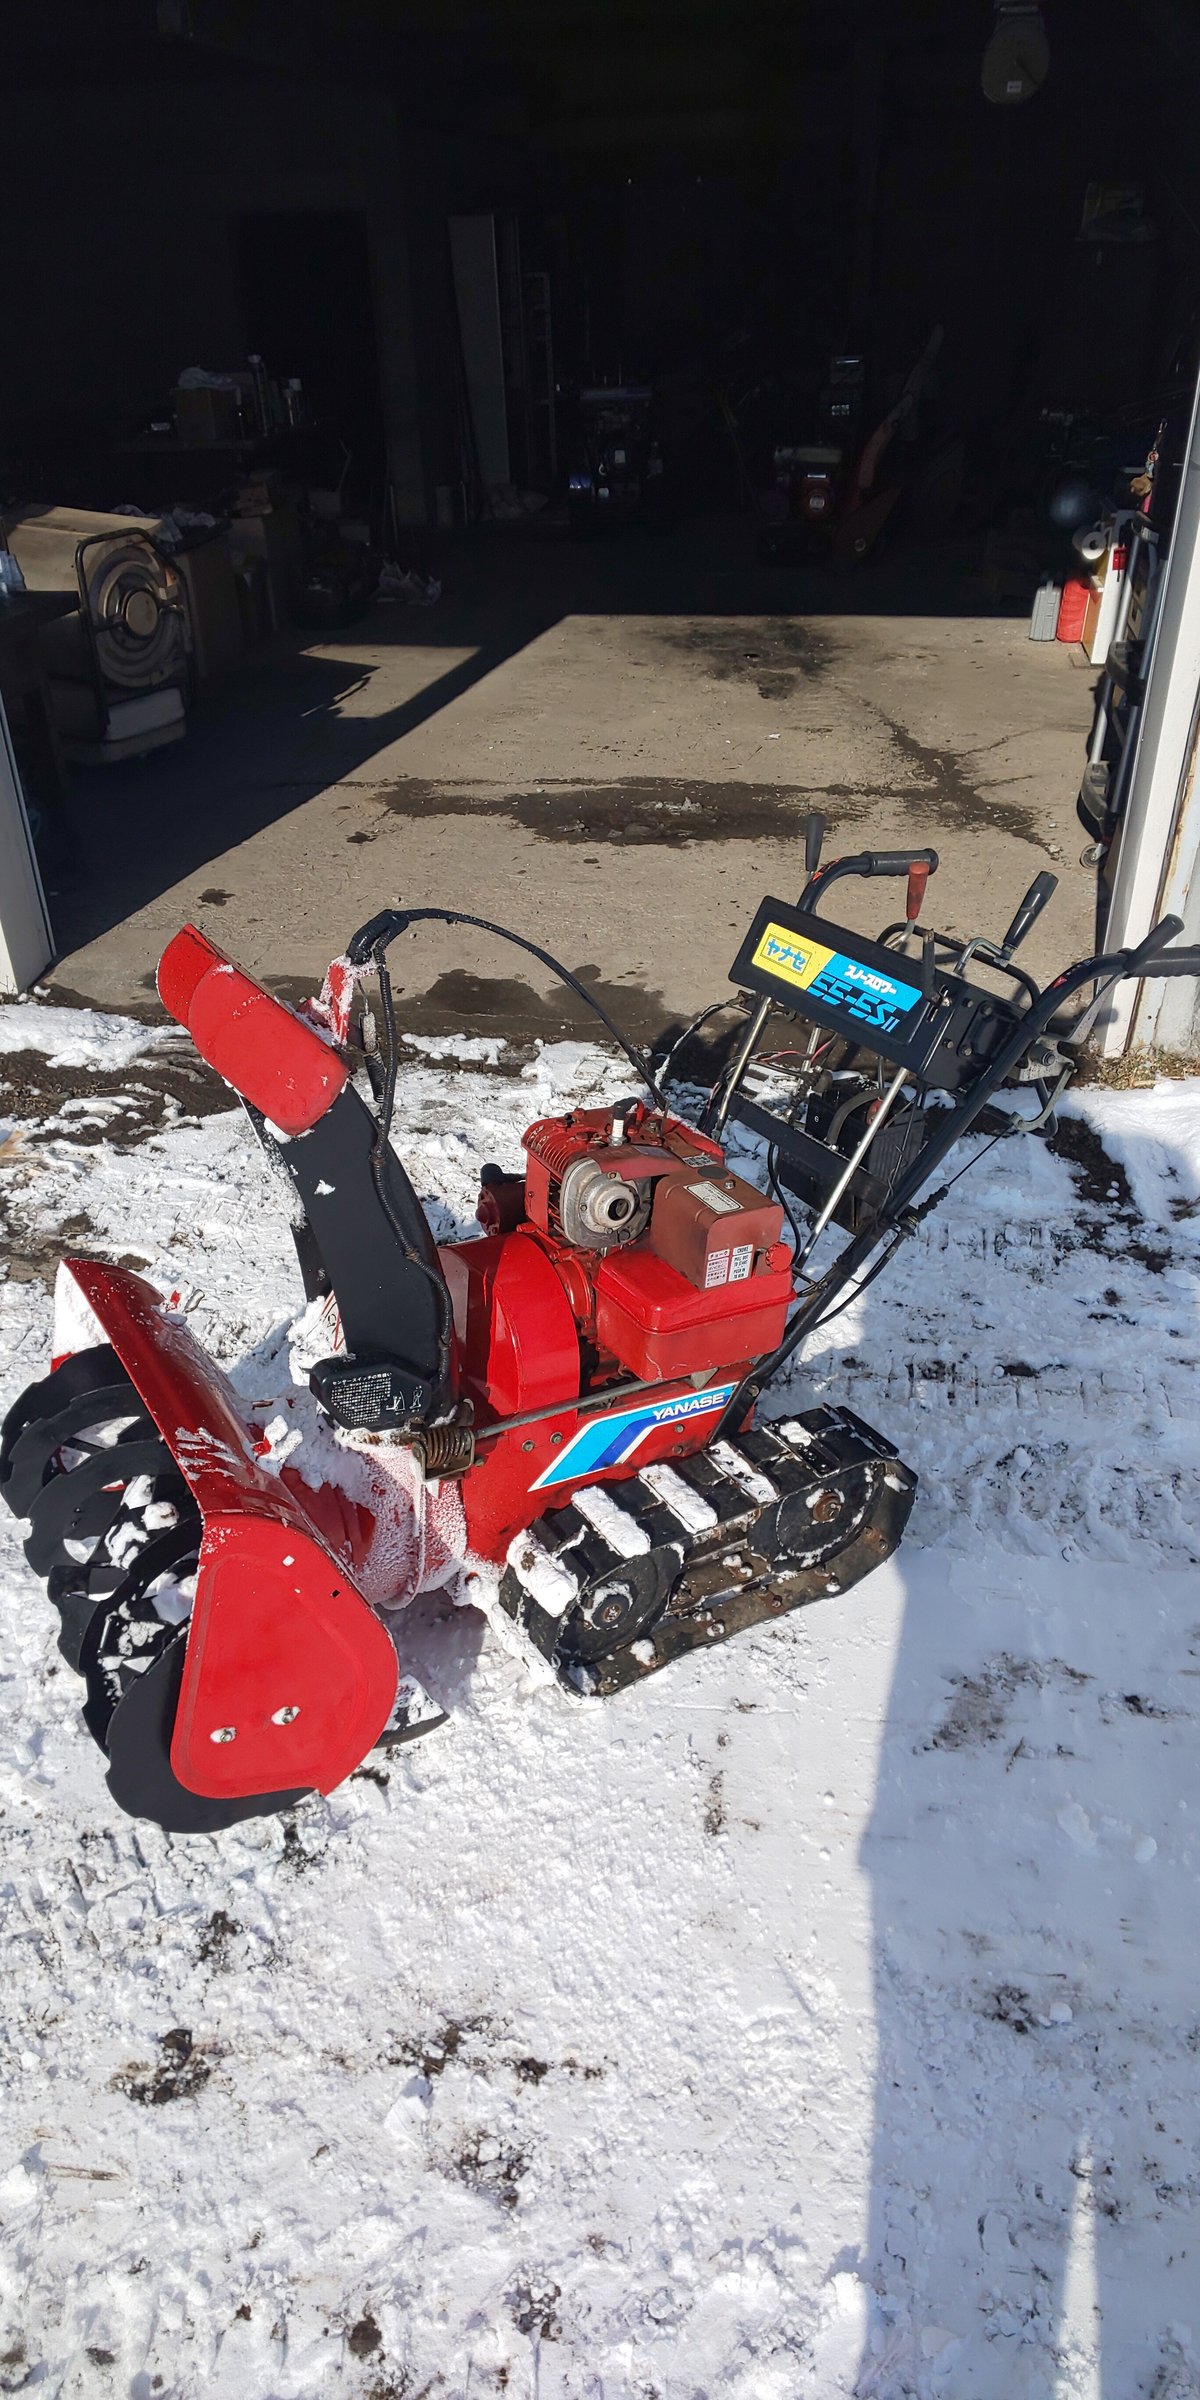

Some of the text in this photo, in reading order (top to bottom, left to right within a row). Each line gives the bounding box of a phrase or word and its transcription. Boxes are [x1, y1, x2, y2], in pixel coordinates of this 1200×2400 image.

[766, 937, 807, 973] ヤナセ
[843, 963, 898, 996] スノースロワー
[652, 1391, 725, 1421] YANASE
